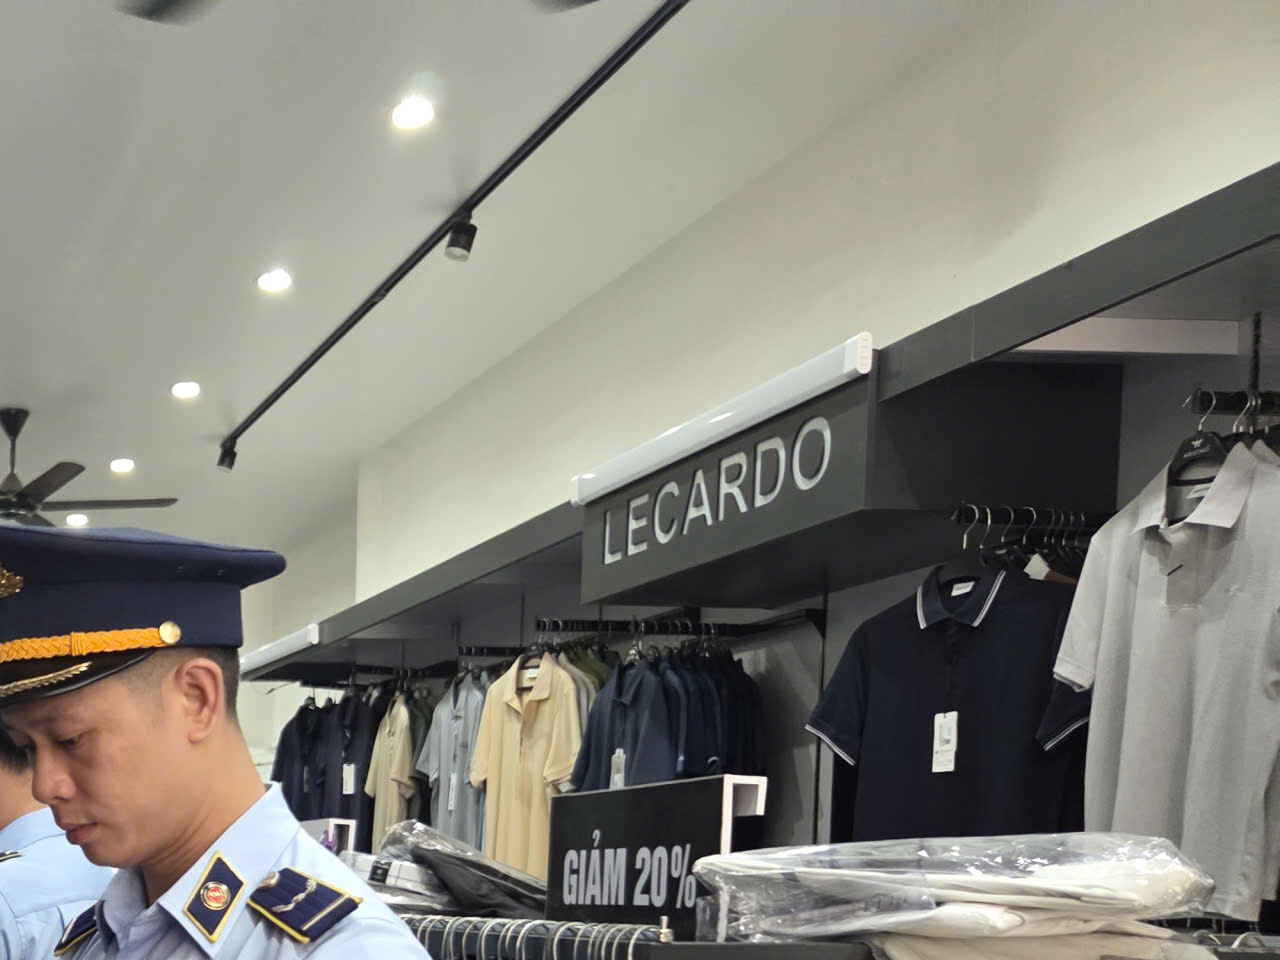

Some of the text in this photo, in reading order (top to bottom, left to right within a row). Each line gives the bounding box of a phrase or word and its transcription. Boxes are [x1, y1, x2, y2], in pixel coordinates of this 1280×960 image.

[603, 416, 832, 565] LECARDO
[563, 829, 697, 909] GIẢM 20%
